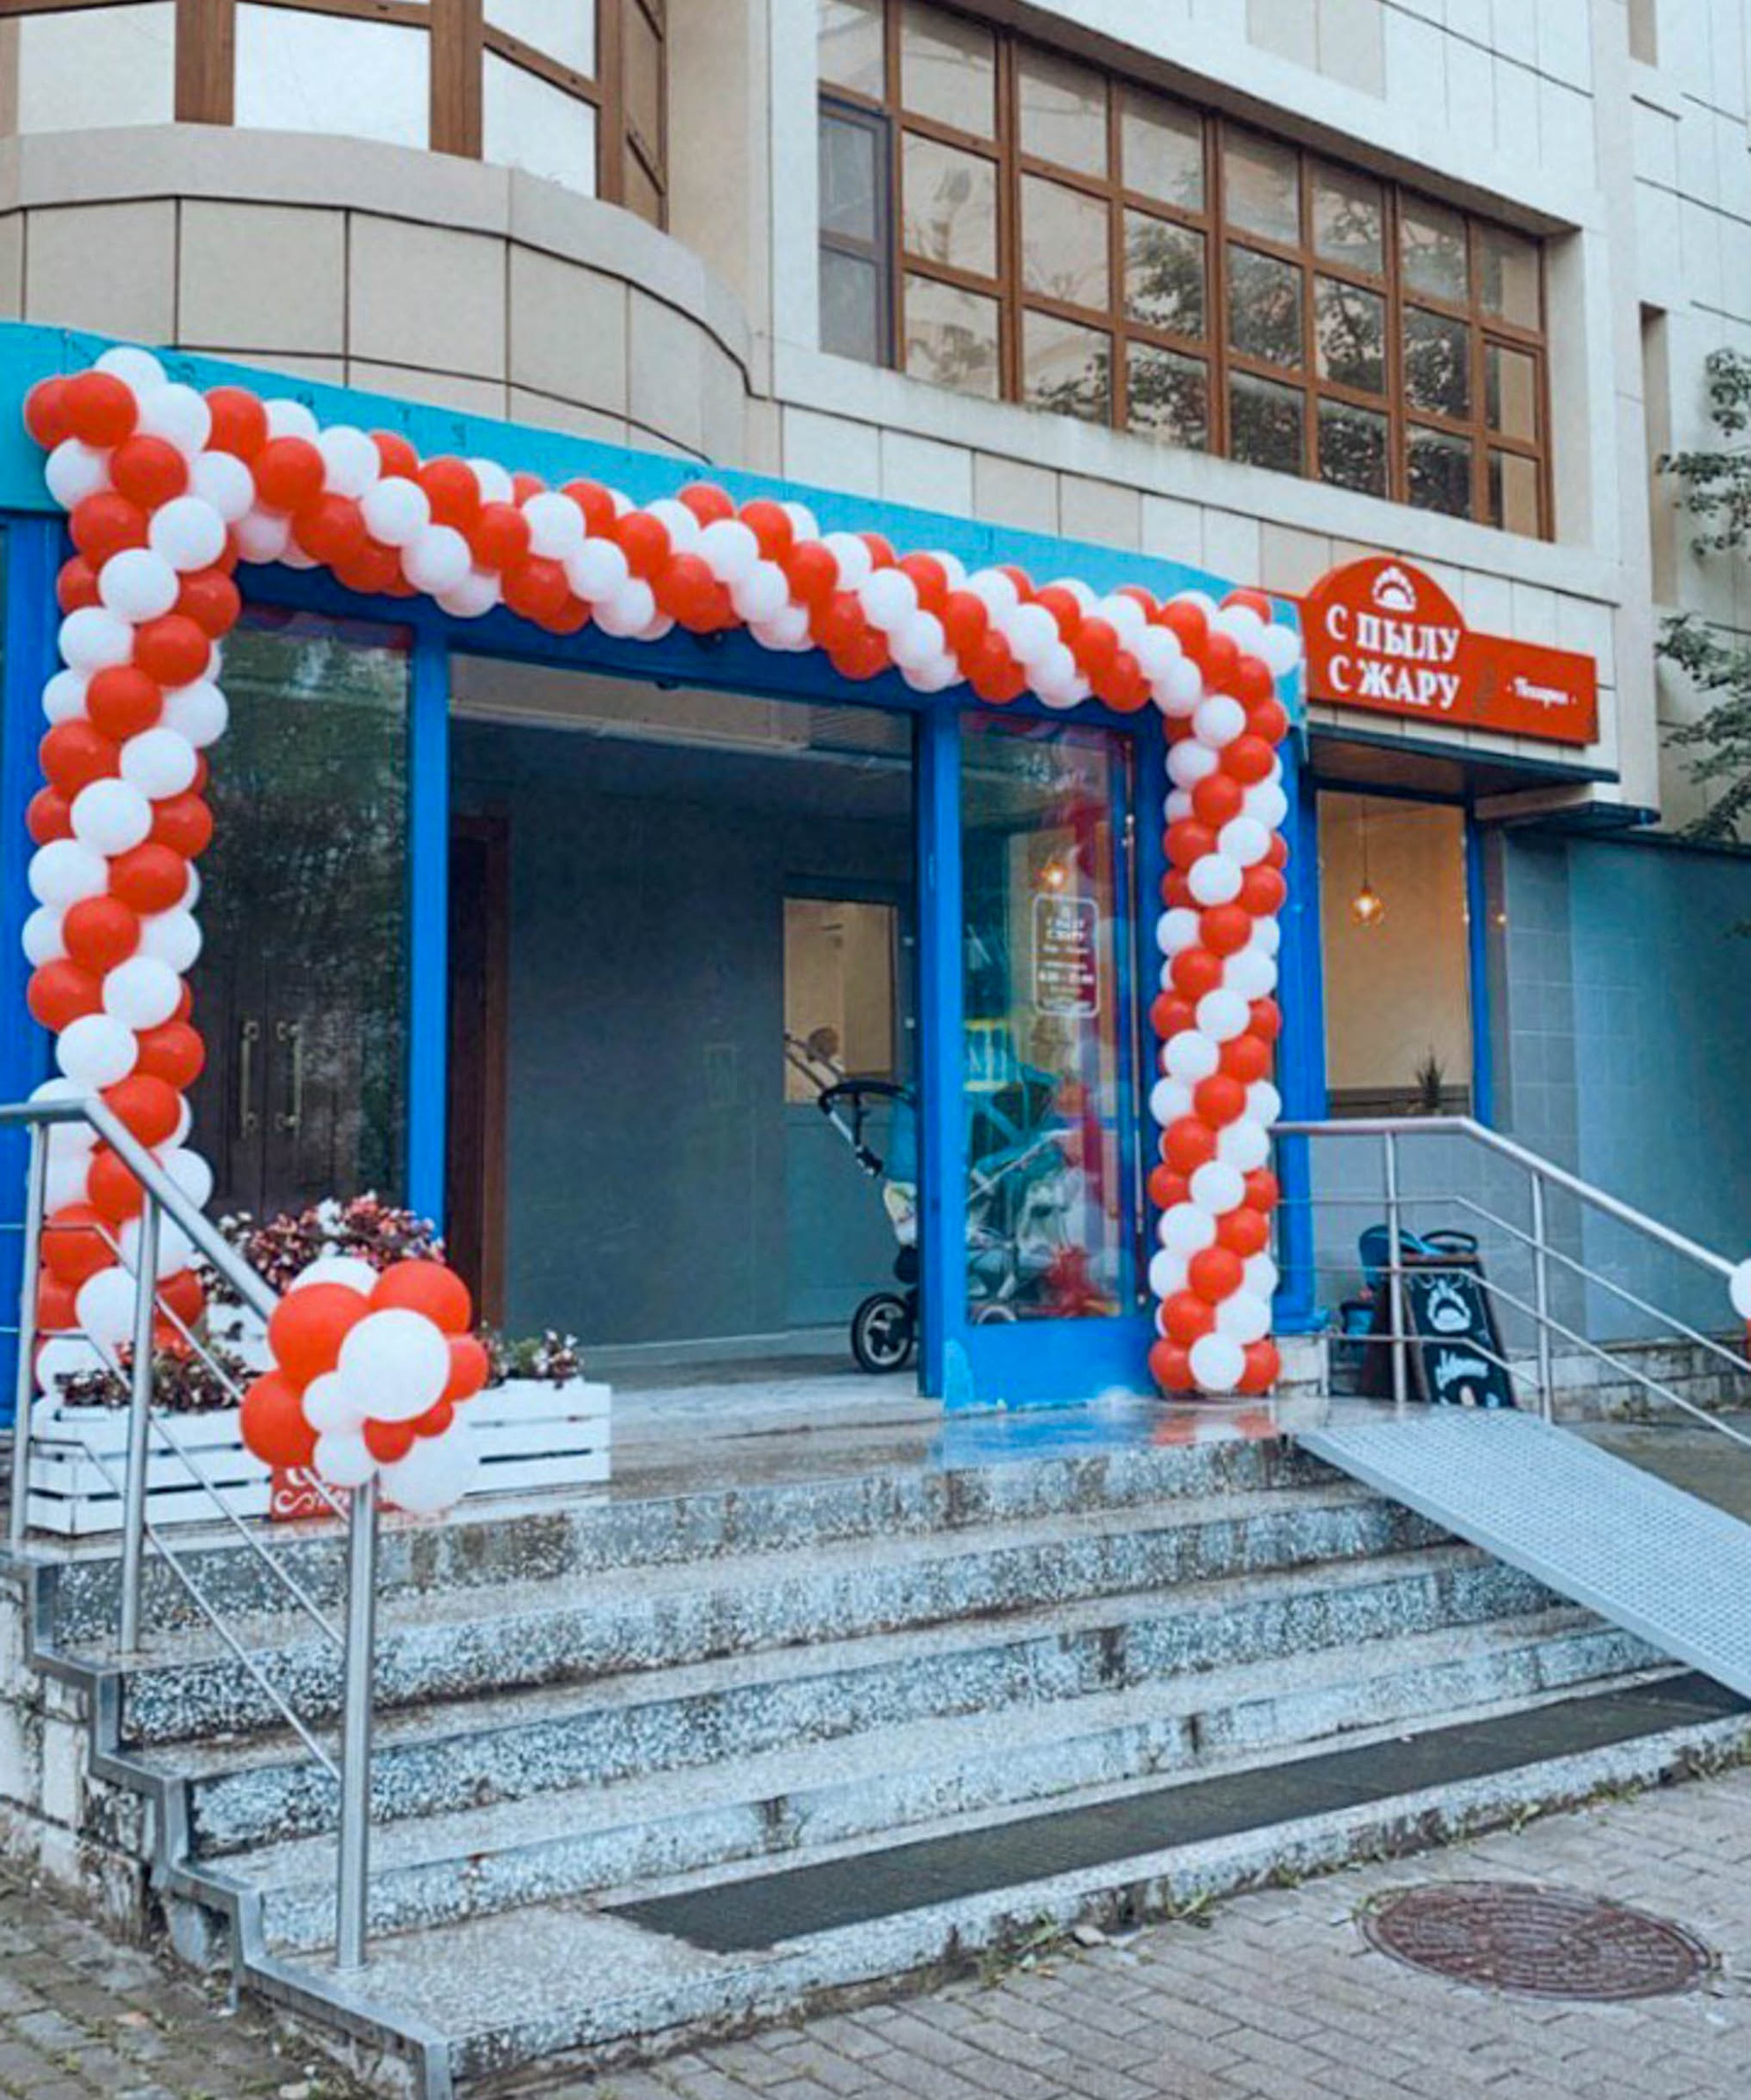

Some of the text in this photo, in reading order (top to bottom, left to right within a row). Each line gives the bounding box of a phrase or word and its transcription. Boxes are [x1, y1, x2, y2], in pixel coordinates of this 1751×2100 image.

[1326, 604, 1460, 662] С ПЫЛУ
[1328, 654, 1459, 711] С ЖАРУ
